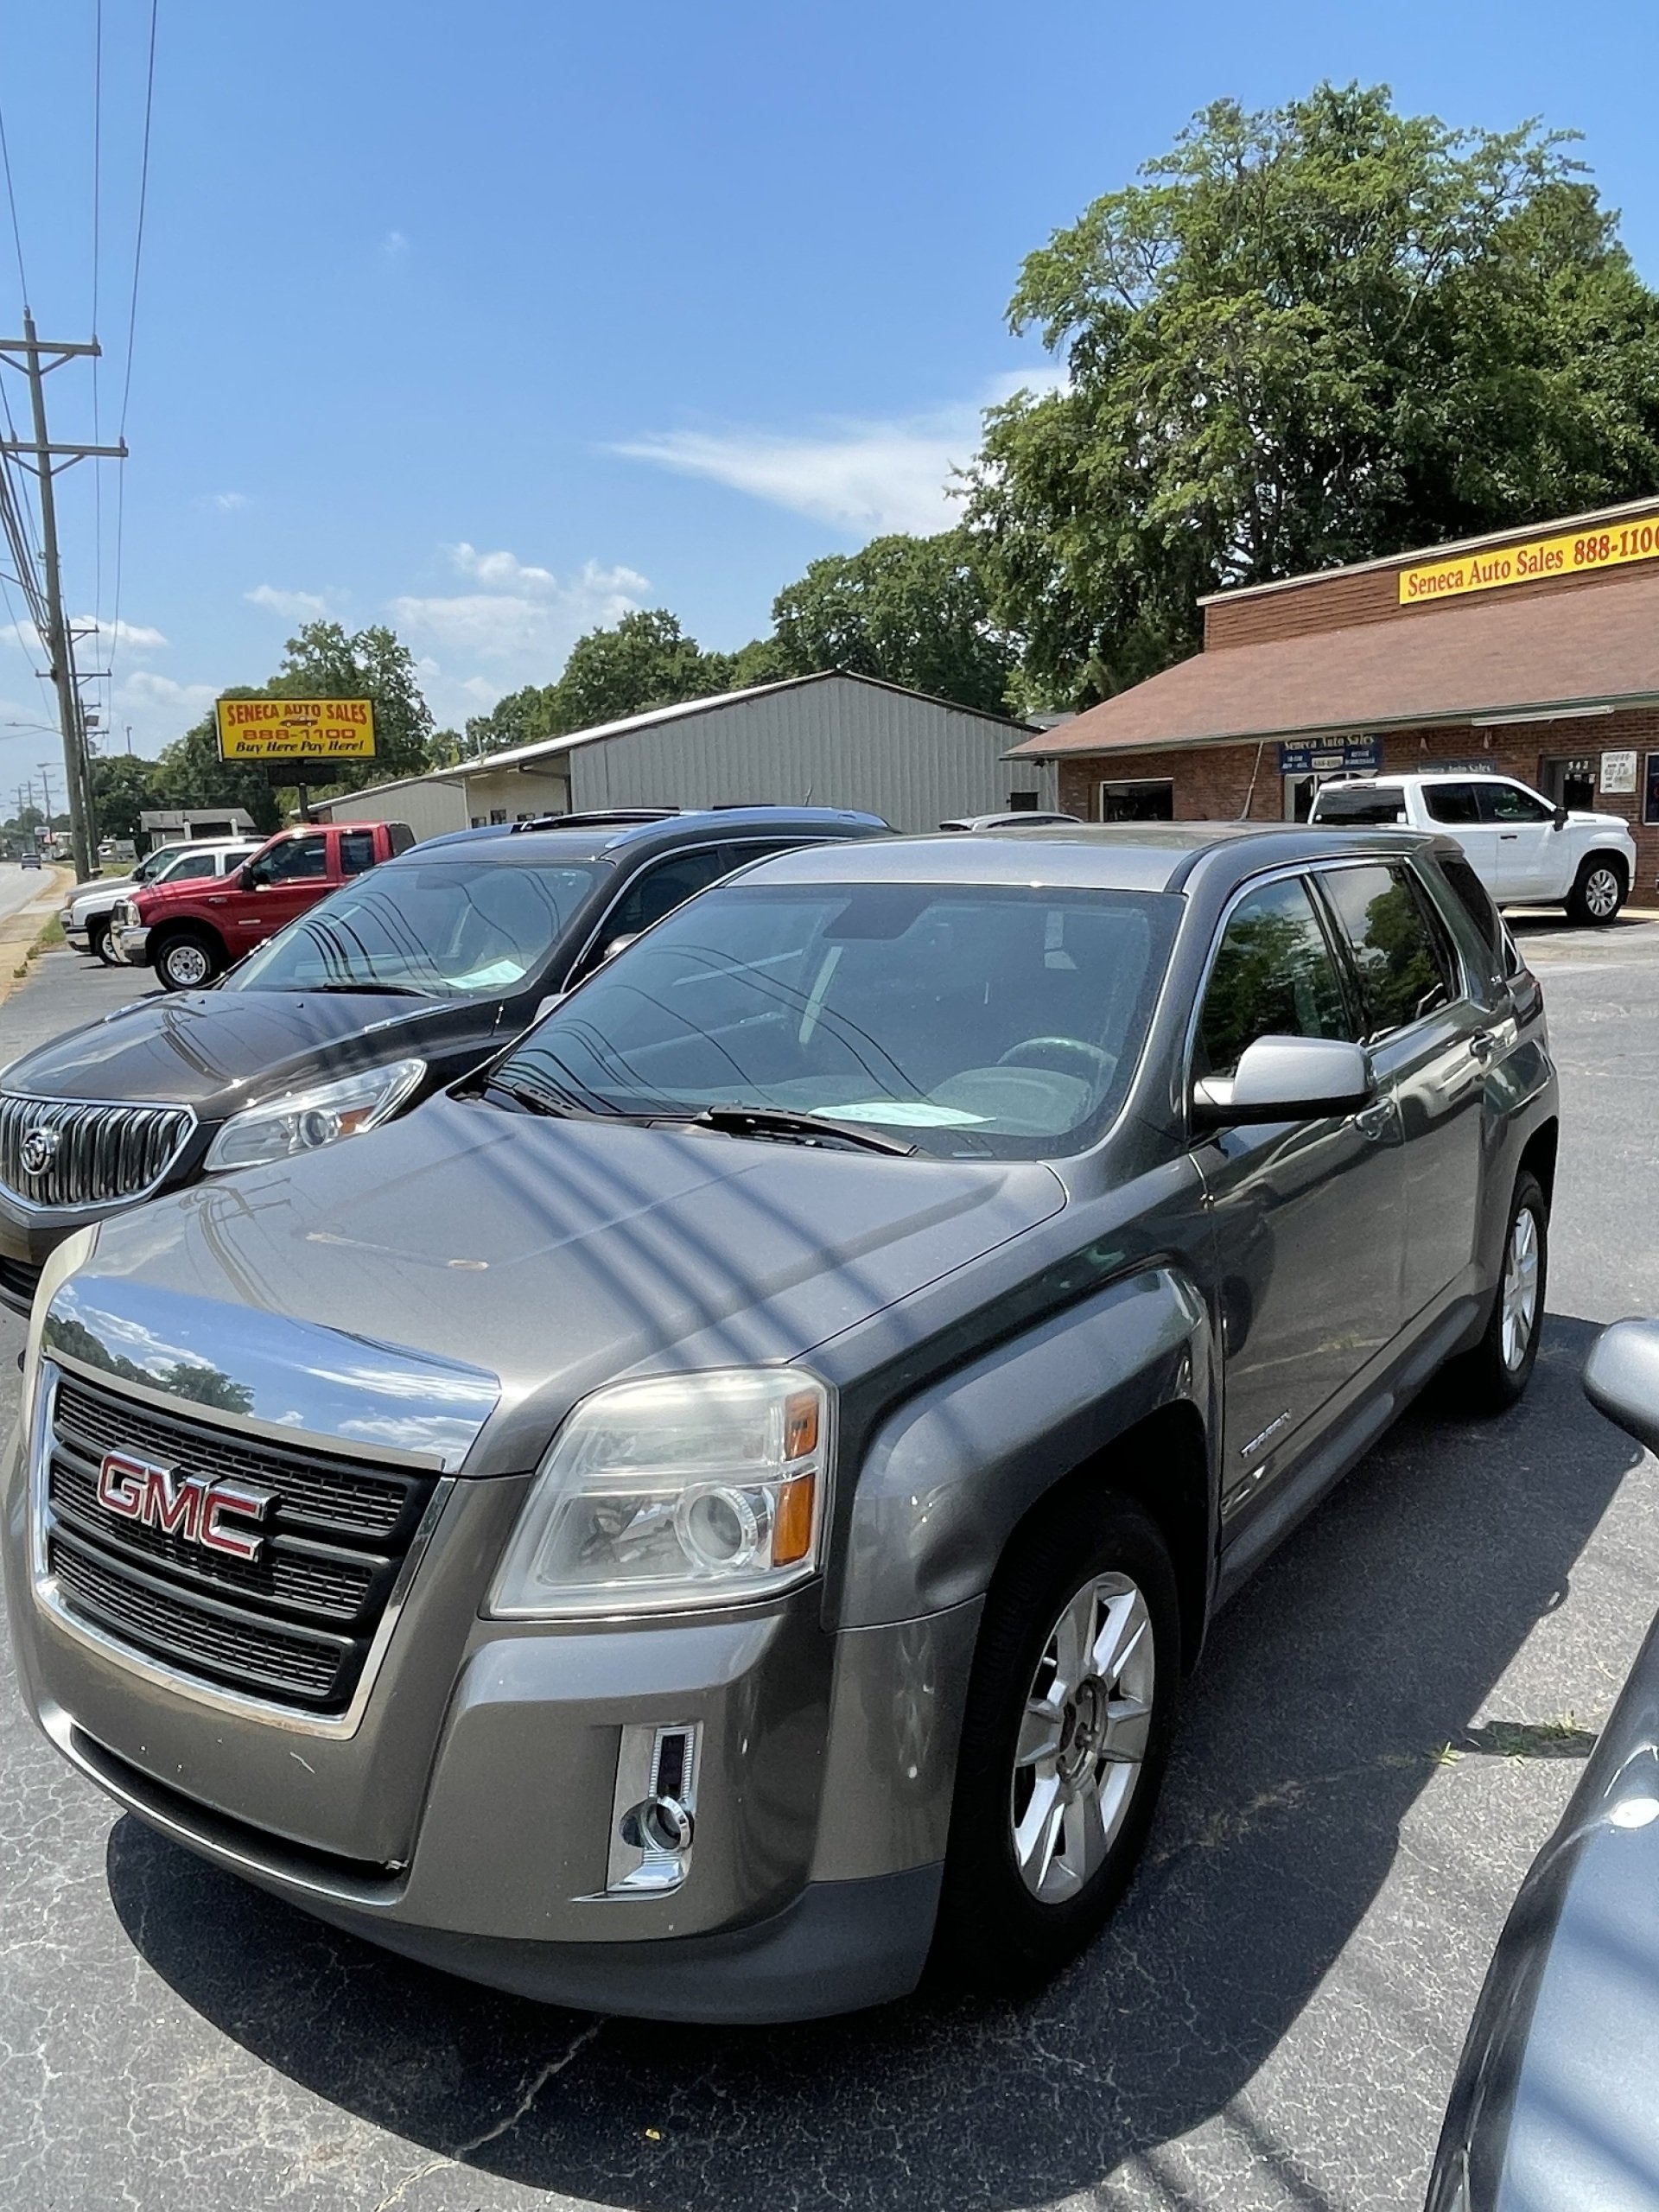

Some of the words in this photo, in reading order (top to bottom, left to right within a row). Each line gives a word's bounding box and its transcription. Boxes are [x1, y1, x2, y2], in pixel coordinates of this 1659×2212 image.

[1408, 572, 1464, 596] Seneca
[1468, 560, 1511, 586] Auto
[1516, 546, 1564, 575] Sales
[226, 704, 280, 727] SENECA
[284, 704, 321, 718] AUTO
[327, 704, 367, 726] SALES
[242, 728, 356, 741] 888-1100
[1347, 734, 1376, 746] Sales
[236, 741, 264, 754] Buy
[266, 741, 298, 752] Here
[301, 740, 325, 754] Pay
[328, 739, 365, 751] Here!
[97, 1448, 275, 1563] GMC
